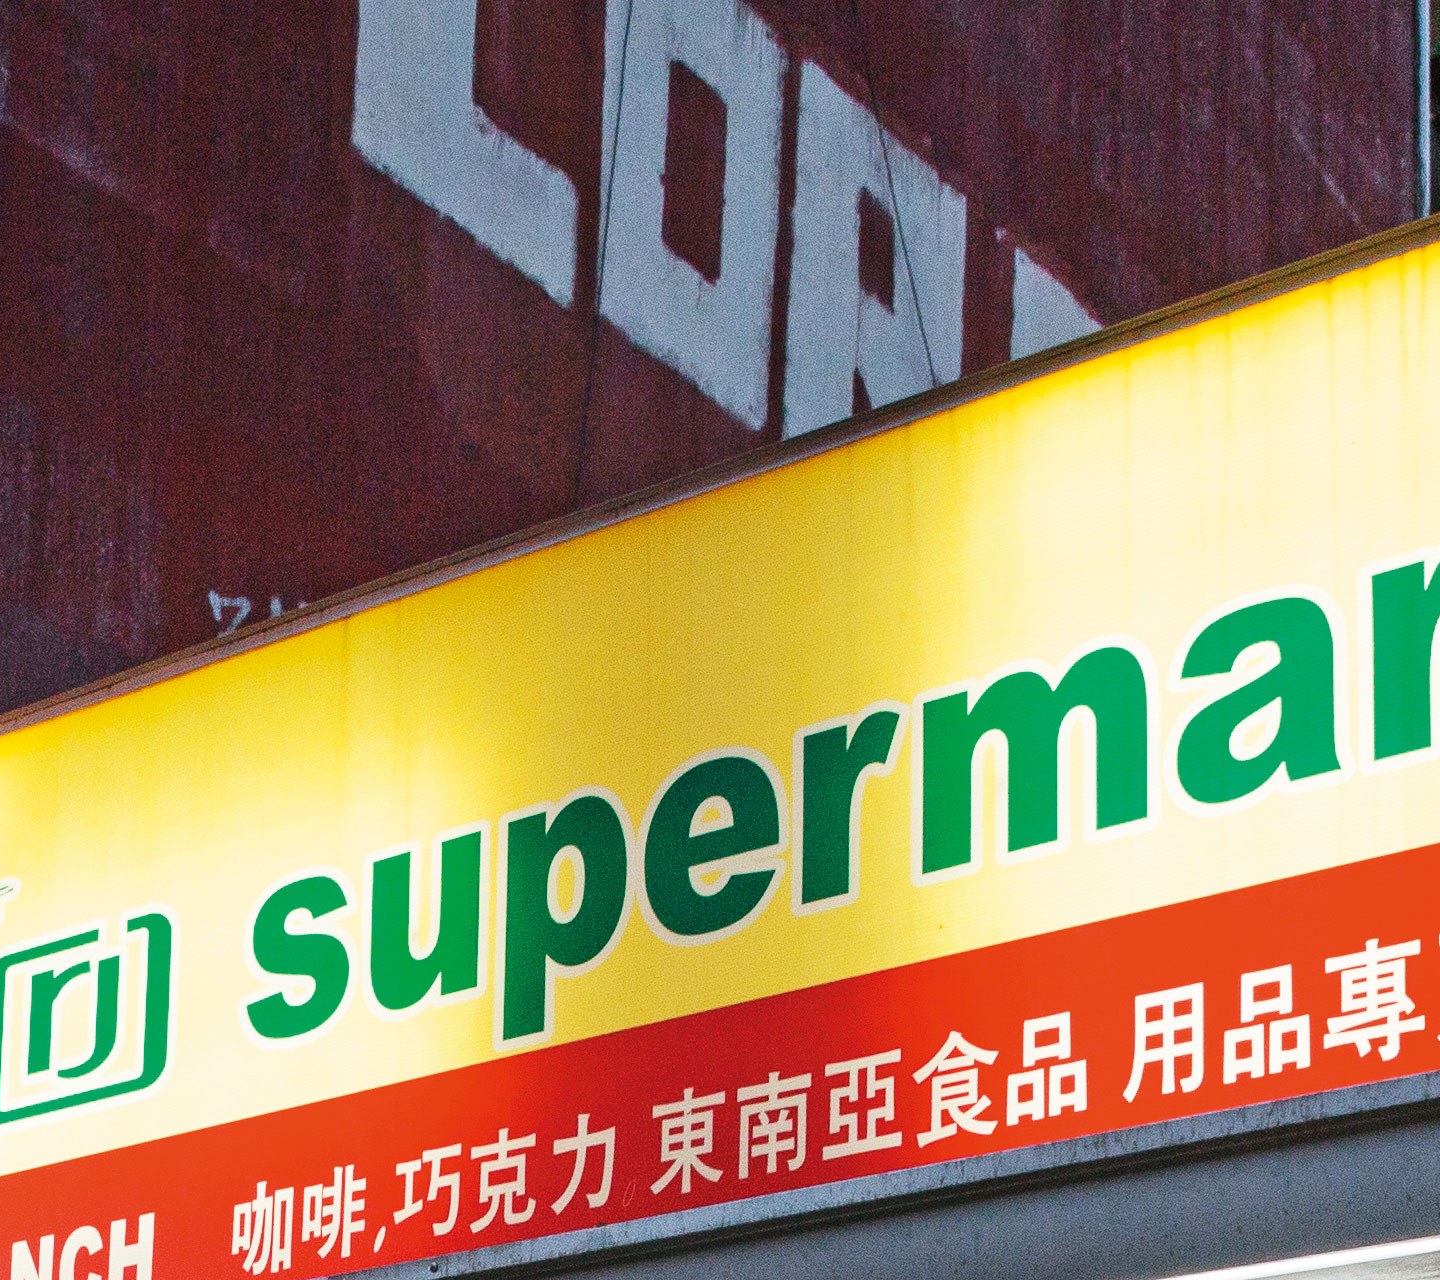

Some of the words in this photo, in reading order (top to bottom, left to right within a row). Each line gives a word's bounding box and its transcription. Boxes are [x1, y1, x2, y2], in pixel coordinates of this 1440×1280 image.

[650, 1010, 1088, 1196] 東南亞食品
